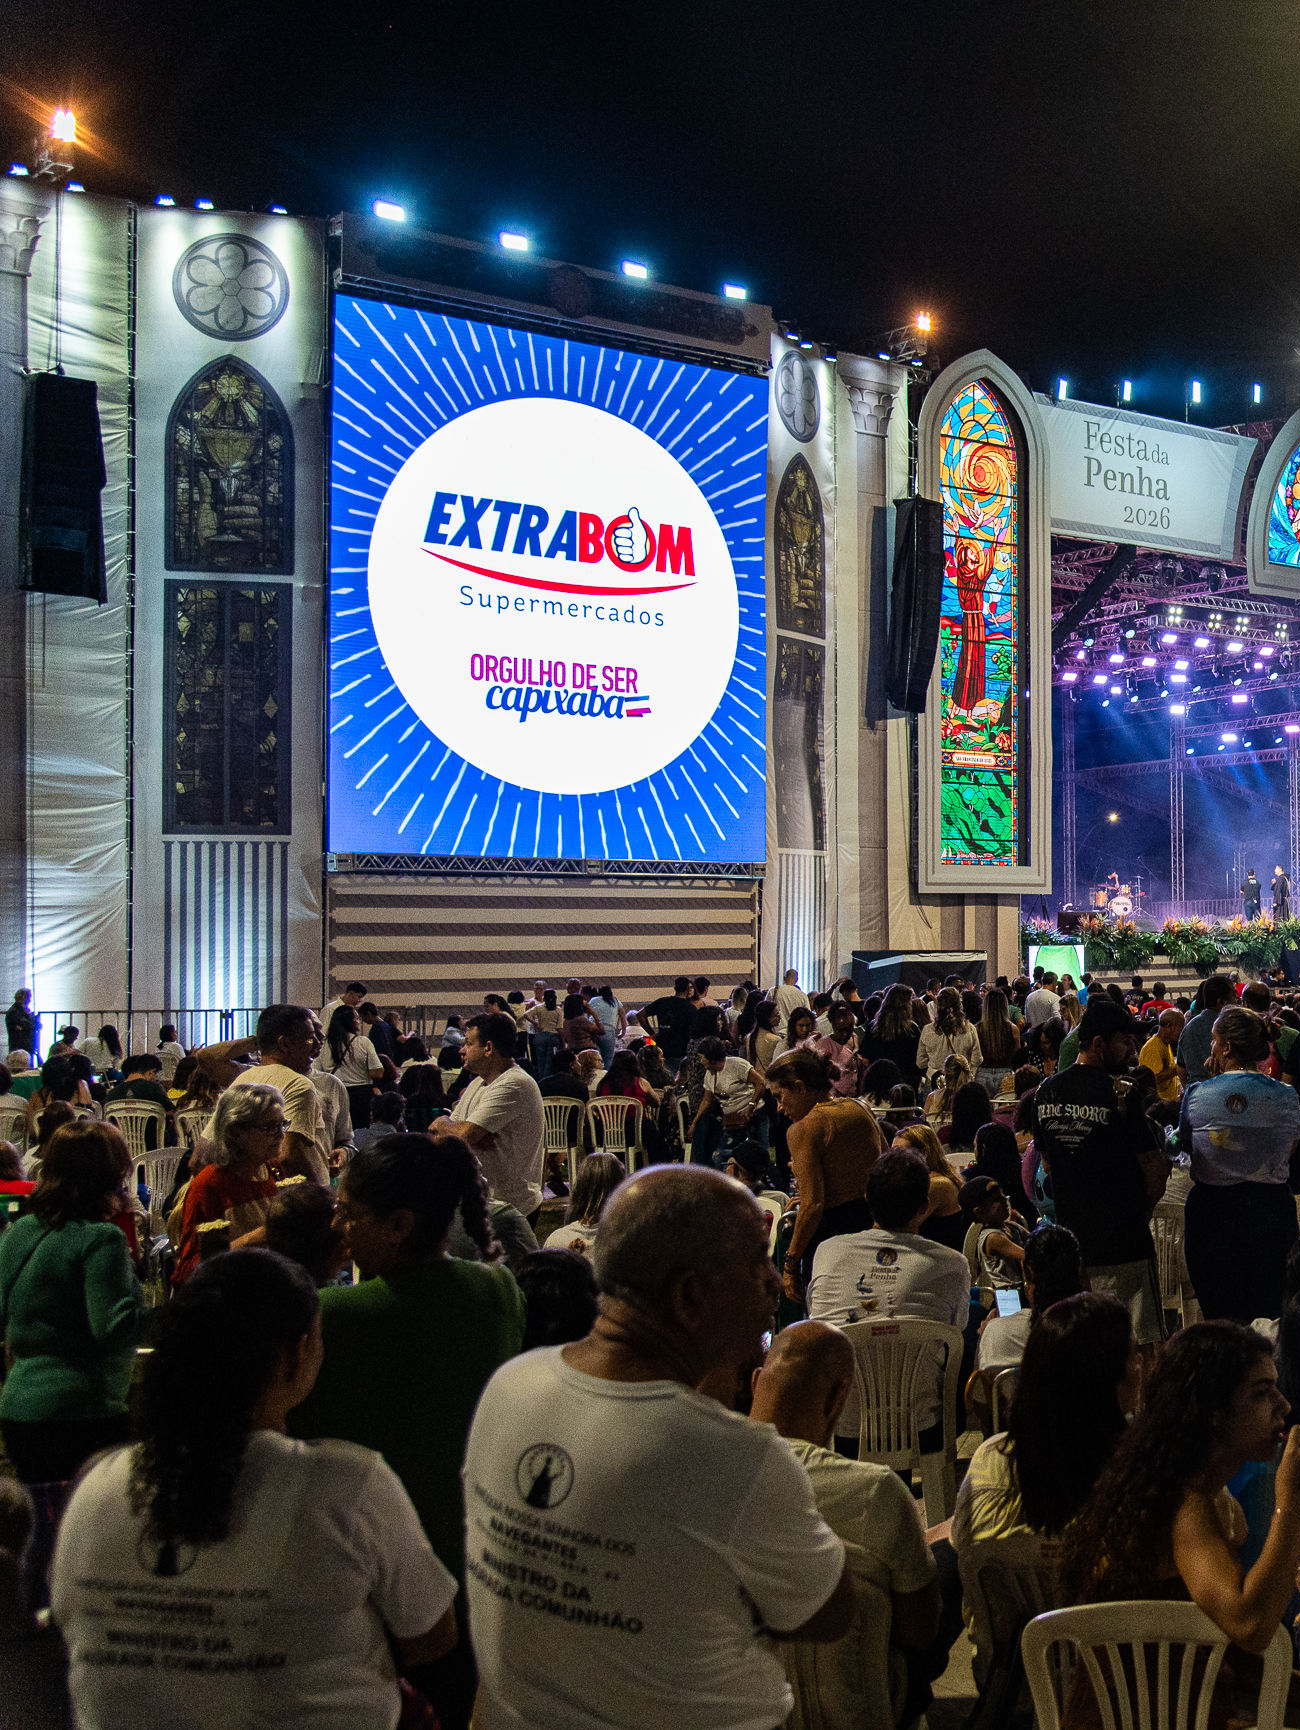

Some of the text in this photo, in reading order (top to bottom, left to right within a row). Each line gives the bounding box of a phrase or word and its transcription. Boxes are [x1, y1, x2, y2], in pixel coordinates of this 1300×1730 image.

[1084, 420, 1170, 466] Festa da
[1084, 456, 1170, 500] Penha
[423, 490, 696, 577] EXTRABOM
[1124, 505, 1170, 530] 2026
[459, 584, 665, 626] Supermercados
[470, 653, 639, 694] ORGULHO DE SER
[486, 678, 626, 724] capixaba
[1064, 1103, 1110, 1126] SPORT
[562, 1579, 592, 1603] DA
